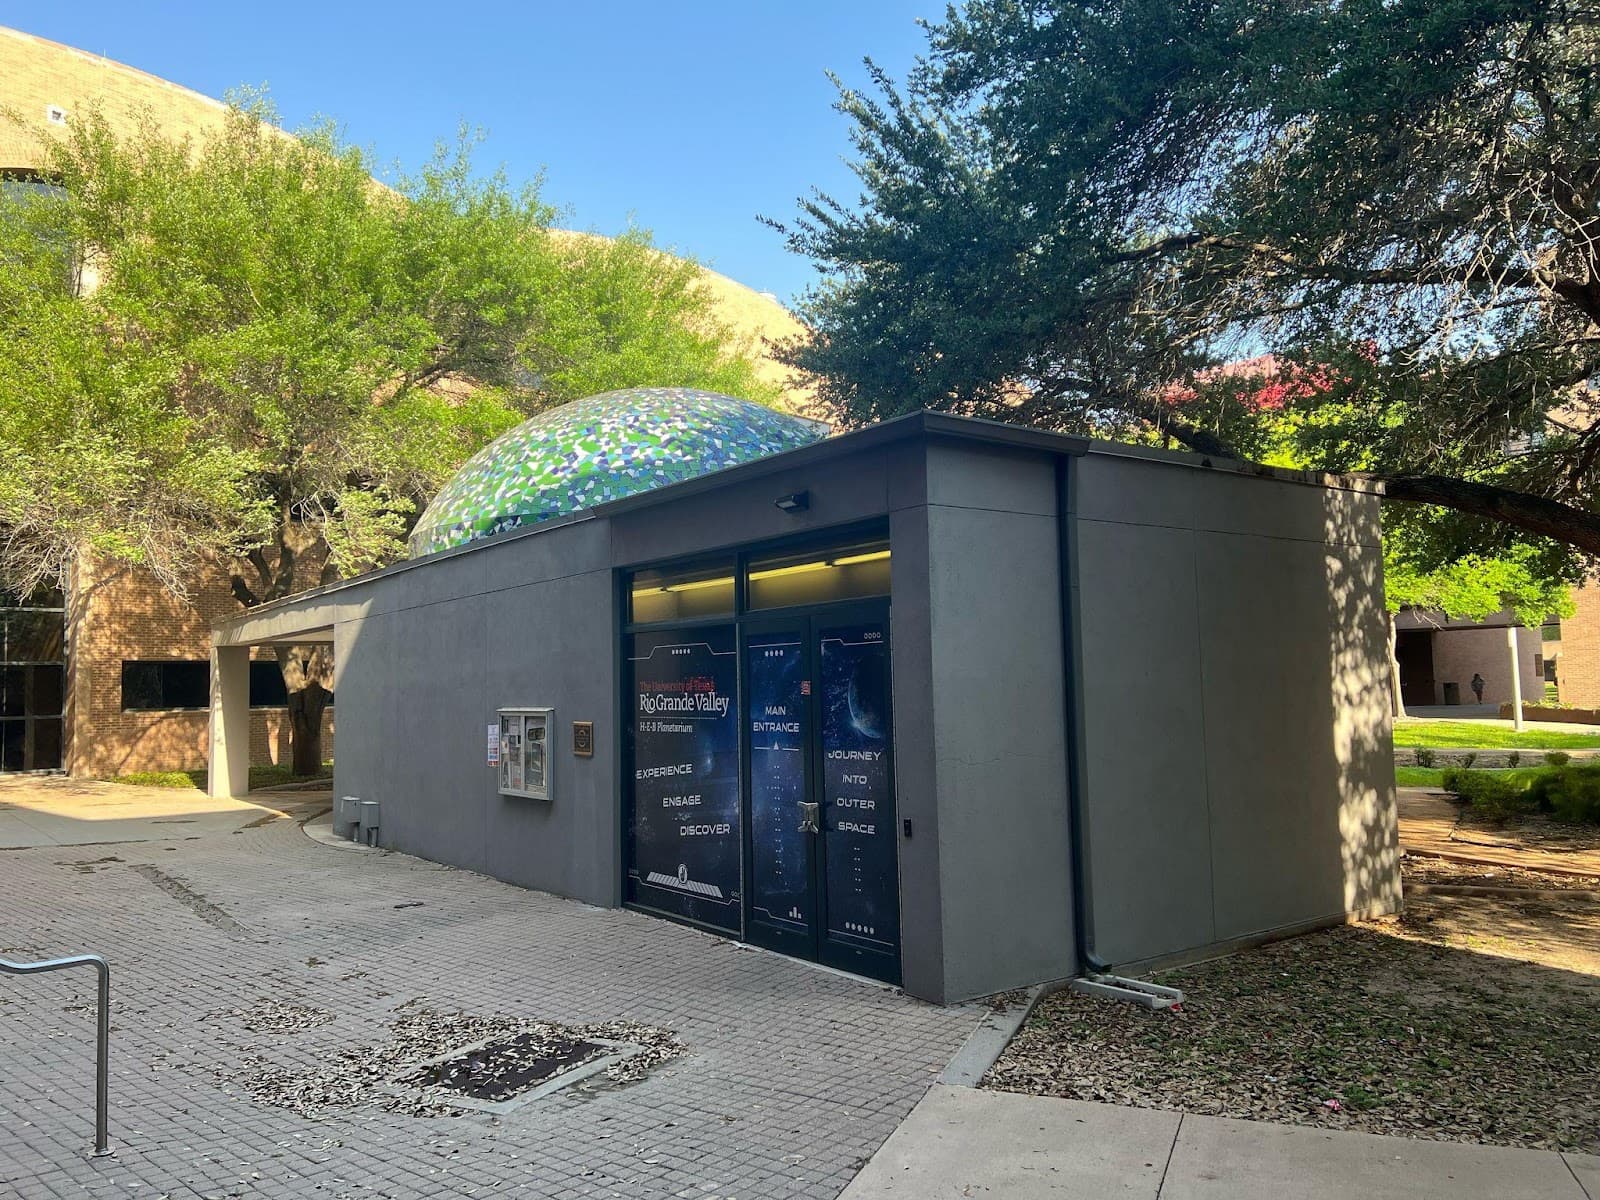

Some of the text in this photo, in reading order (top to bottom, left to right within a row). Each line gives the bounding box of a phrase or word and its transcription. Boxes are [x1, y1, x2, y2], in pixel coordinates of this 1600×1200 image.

[656, 692, 694, 711] Grande
[694, 690, 730, 717] Valley
[765, 706, 786, 716] MAIN
[640, 722, 693, 733] H-E-B Planetarium
[753, 722, 800, 733] ENTRANCE
[828, 750, 881, 761] JOURNEY
[636, 764, 693, 780] EXPERIENCE
[842, 774, 868, 785] INTO
[662, 795, 702, 808] ENGAGE
[836, 798, 876, 810] OUTER
[680, 823, 731, 836] DISCOVER
[838, 821, 876, 835] SPACE
